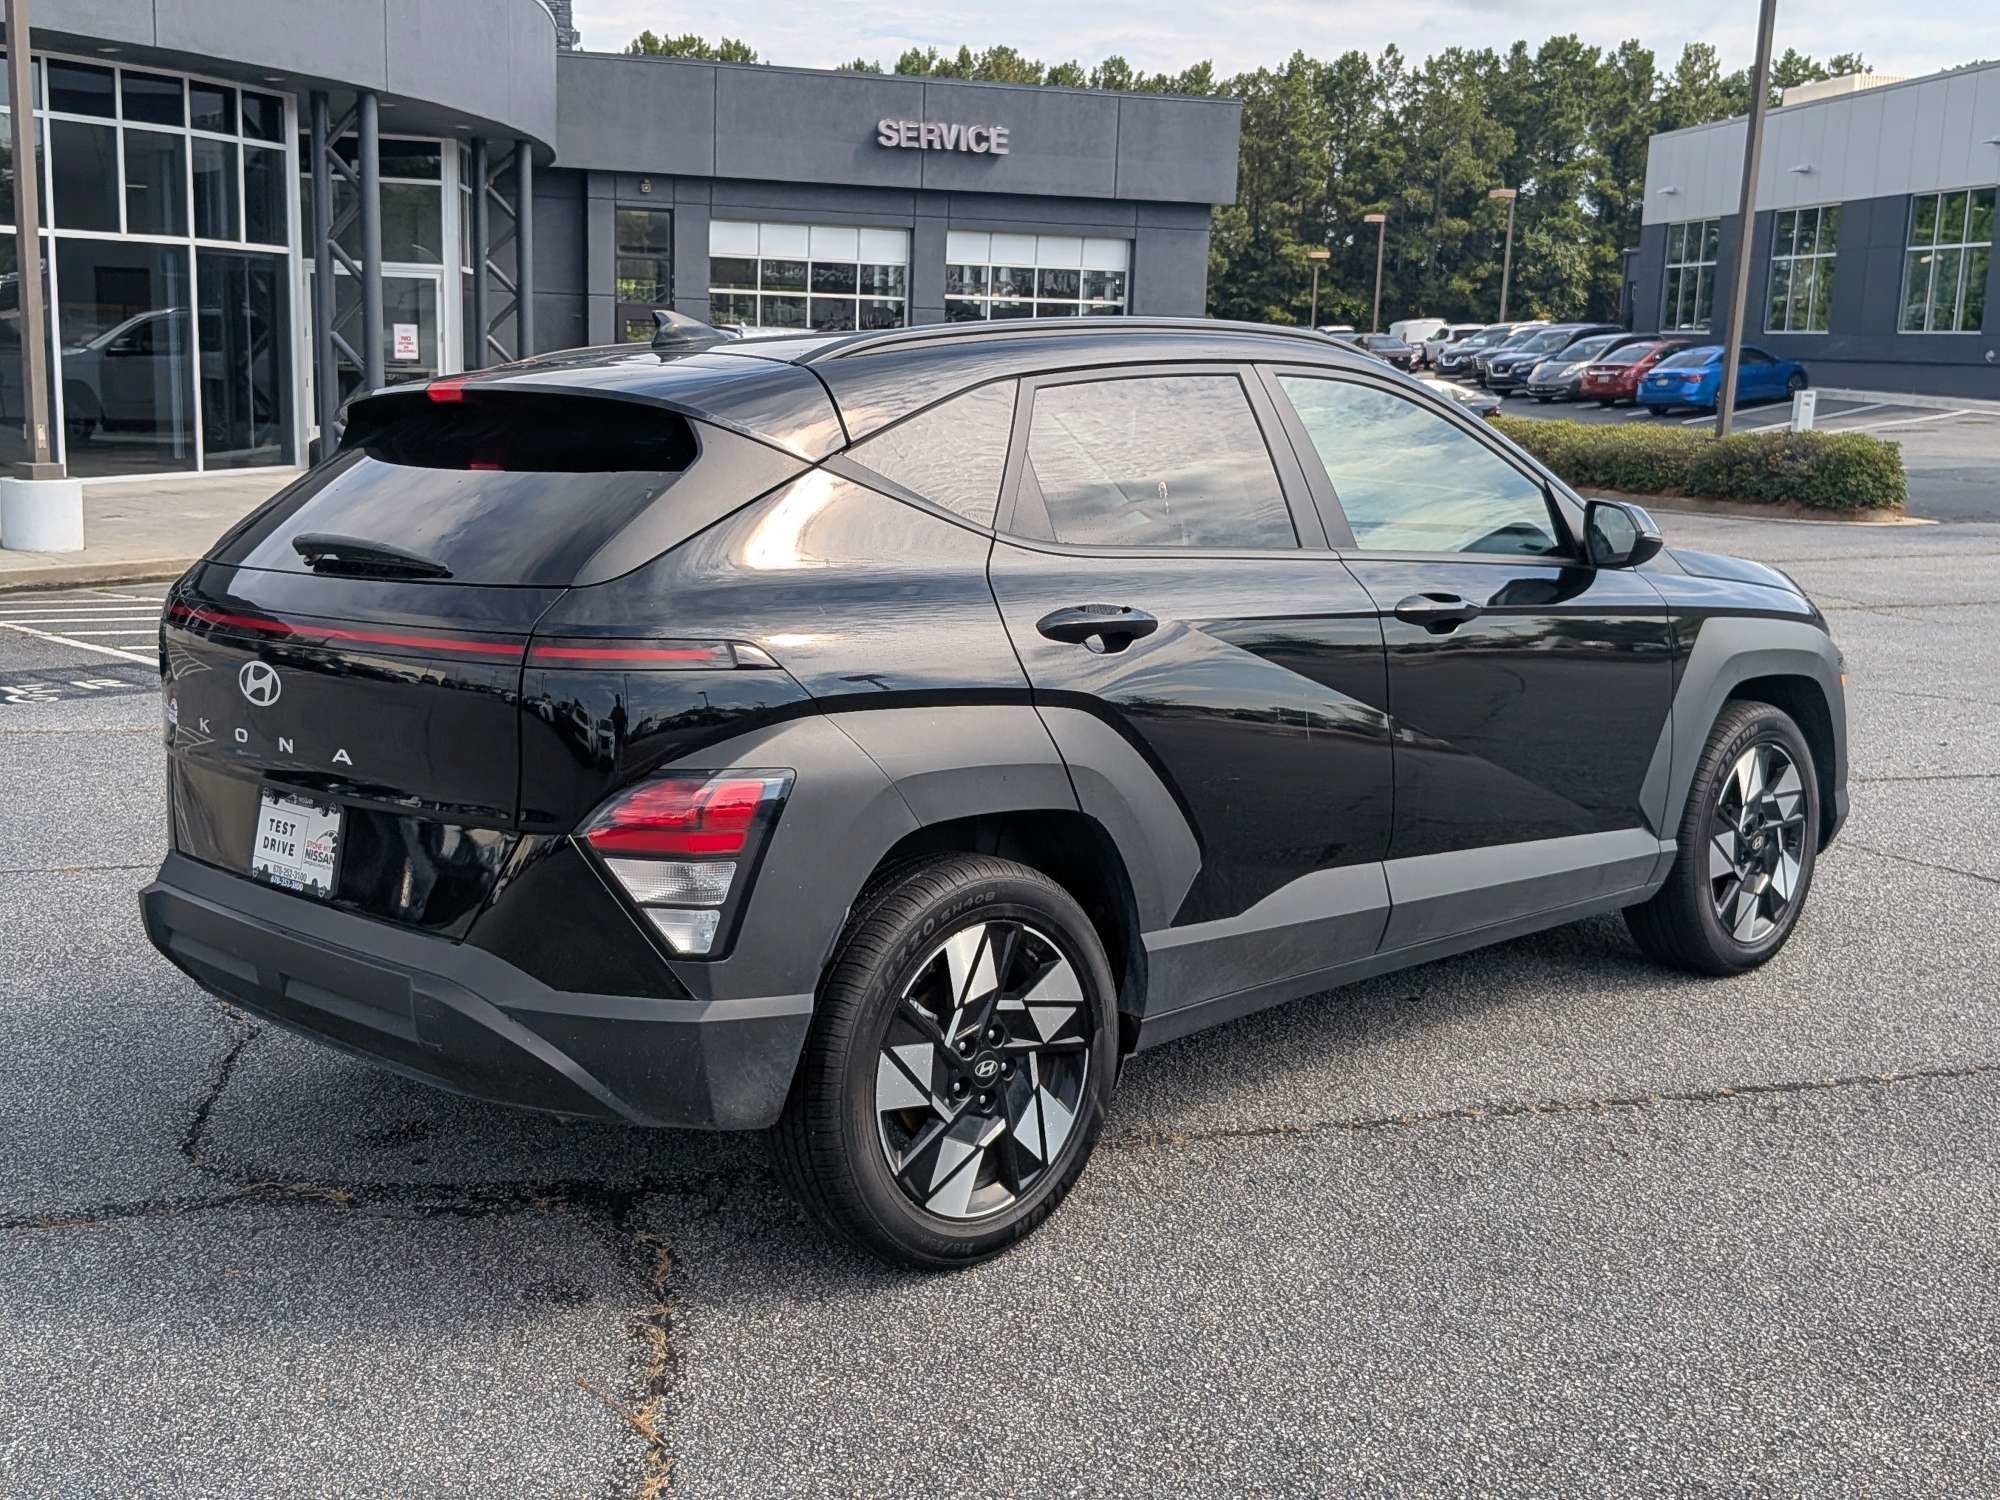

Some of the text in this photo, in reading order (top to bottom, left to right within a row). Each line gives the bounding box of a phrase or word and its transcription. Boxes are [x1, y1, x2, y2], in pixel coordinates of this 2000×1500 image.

[877, 118, 1010, 155] SERVICE
[199, 717, 353, 766] KONA
[269, 818, 296, 837] TEST
[262, 836, 295, 857] DRIVE
[304, 848, 337, 865] NISSAN
